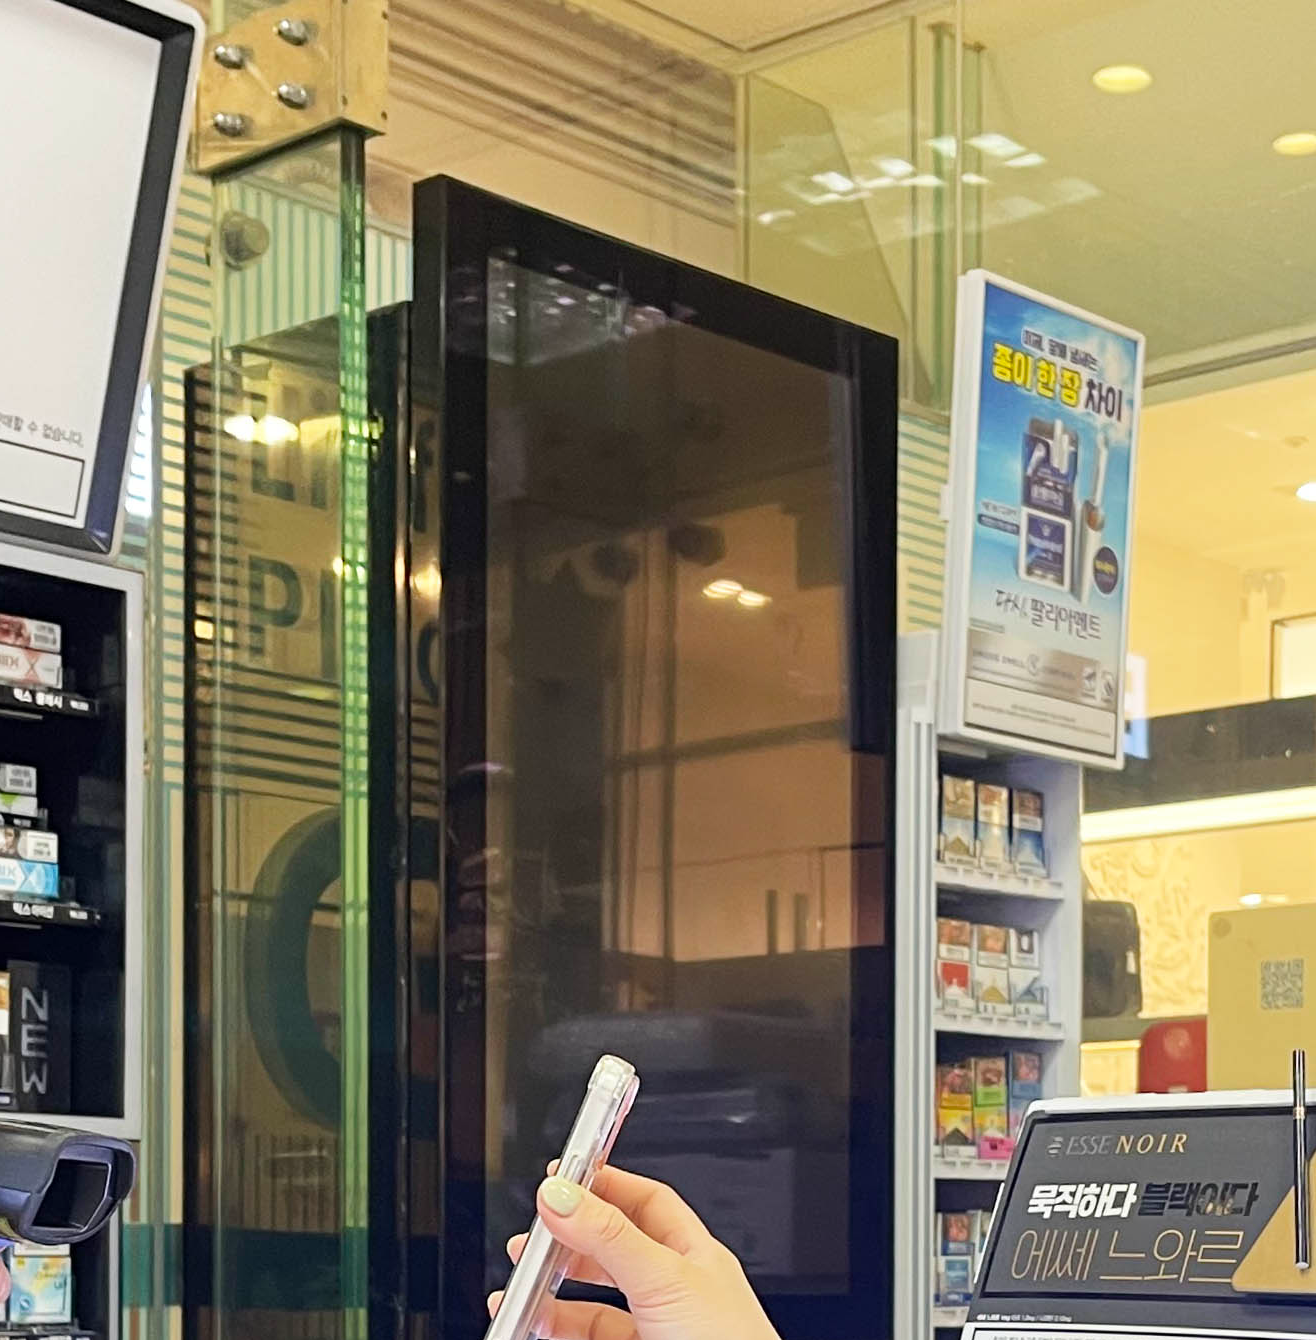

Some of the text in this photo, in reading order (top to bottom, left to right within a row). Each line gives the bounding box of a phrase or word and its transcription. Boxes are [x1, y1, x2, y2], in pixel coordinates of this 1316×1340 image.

[1085, 378, 1122, 422] 차이
[21, 987, 48, 1094] NEW
[1066, 1133, 1187, 1156] ESSE NOIR
[1027, 1181, 1260, 1219] 묵직하다 블랙이다
[1011, 1228, 1244, 1283] 에쎄 느와르
